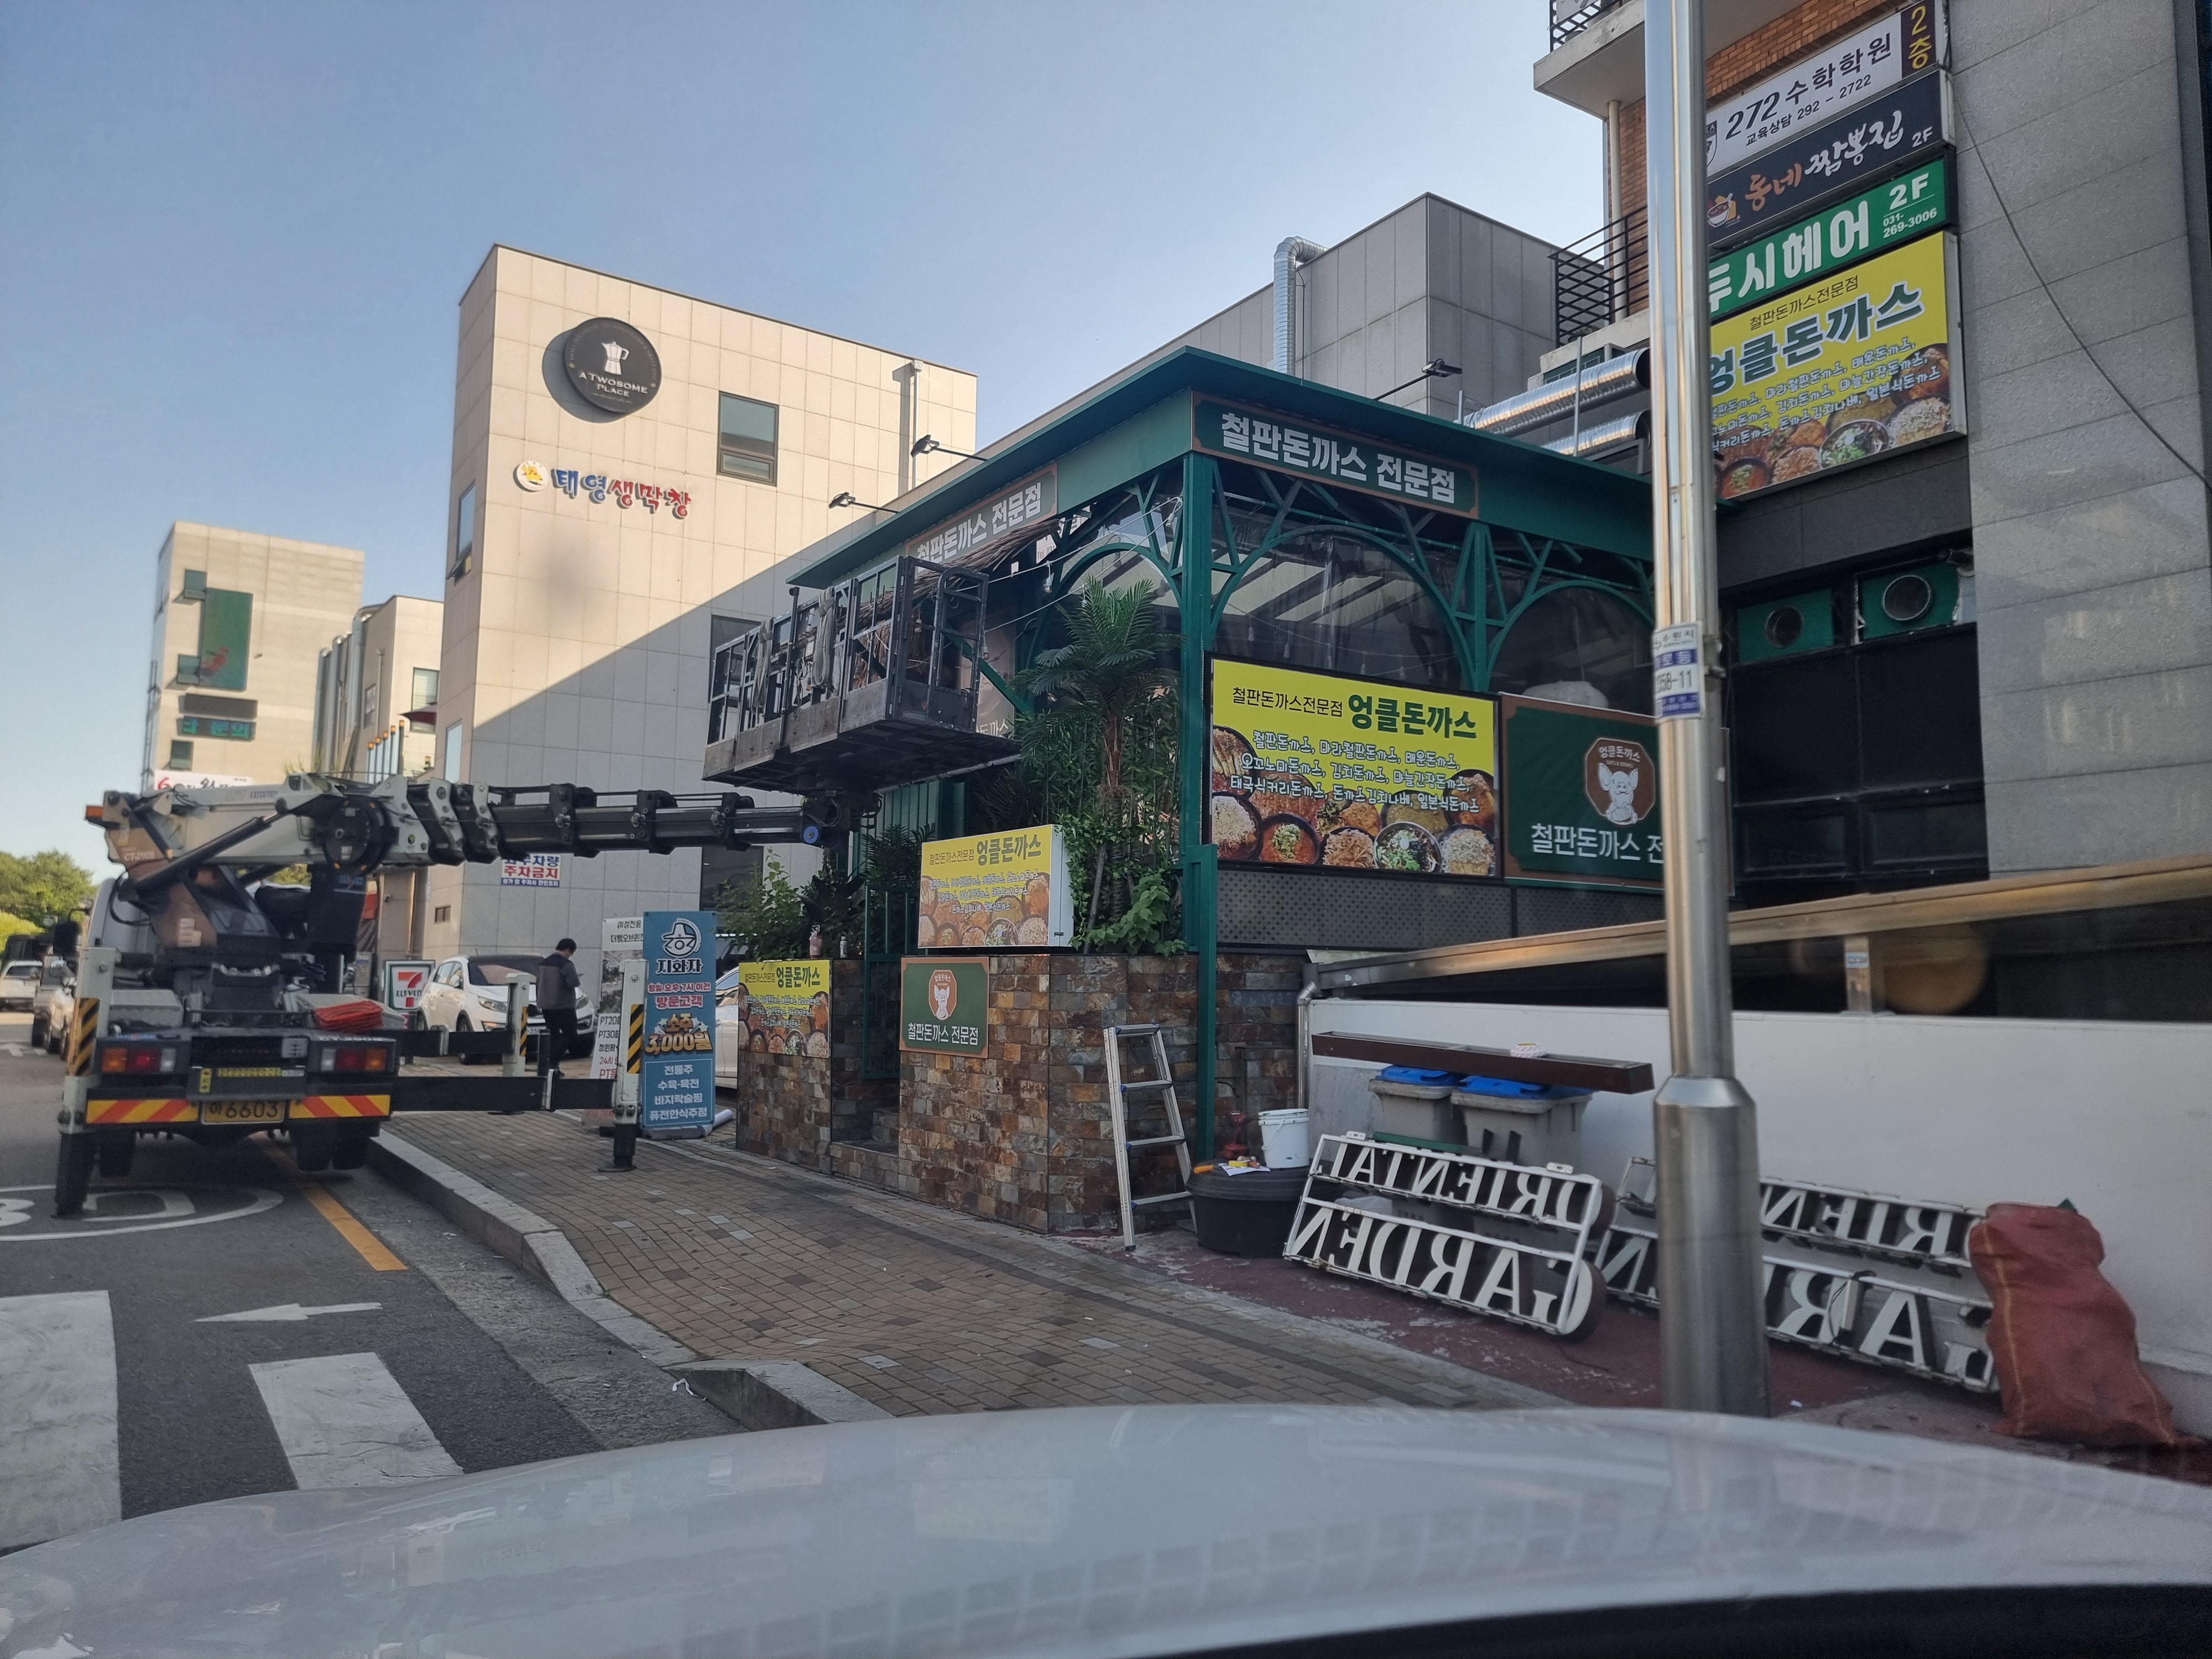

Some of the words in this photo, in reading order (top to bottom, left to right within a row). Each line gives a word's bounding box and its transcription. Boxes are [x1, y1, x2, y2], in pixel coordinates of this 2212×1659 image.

[1908, 6, 1932, 69] 2층
[1745, 114, 1792, 147] 교육상담
[1745, 163, 1802, 211] 동네
[1804, 111, 1903, 177] 짬뽕집
[1912, 127, 1933, 148] 2F
[1889, 173, 1929, 210] 2F
[1884, 208, 1937, 238] 269-3006
[1750, 275, 1859, 331] 철판돈까스전문점
[580, 372, 587, 380] A
[588, 372, 648, 394] TWOSOME
[597, 384, 630, 397] PLACE
[1222, 412, 1367, 482] 철판돈까스
[1377, 453, 1455, 504] 전문점
[992, 482, 1041, 535] 전문점
[1232, 687, 1343, 717] 철판돈까스전문점
[1348, 694, 1478, 740] 엉클돈까스
[1253, 730, 1314, 754] 철판돈까스,
[1417, 792, 1480, 813] 일본식돈까스
[930, 849, 974, 865] 철판돈까스전문점
[977, 834, 1041, 866] 엉클돈까스
[1531, 823, 1640, 861] 철판돈까스
[504, 865, 557, 879] 주차금지
[656, 958, 703, 974] 지화자
[776, 966, 820, 988] 엉클돈까스
[664, 983, 680, 993] 오후
[681, 983, 694, 992] 7시
[696, 982, 711, 992] 이전
[655, 995, 703, 1009] 방문고객
[666, 1013, 693, 1032] 소주
[908, 1022, 949, 1042] 철판돈까스
[951, 1026, 978, 1046] 전문점
[645, 1031, 713, 1055] 3,000원
[665, 1065, 693, 1075] 전통주
[650, 1107, 707, 1121] 퓨전한식주점
